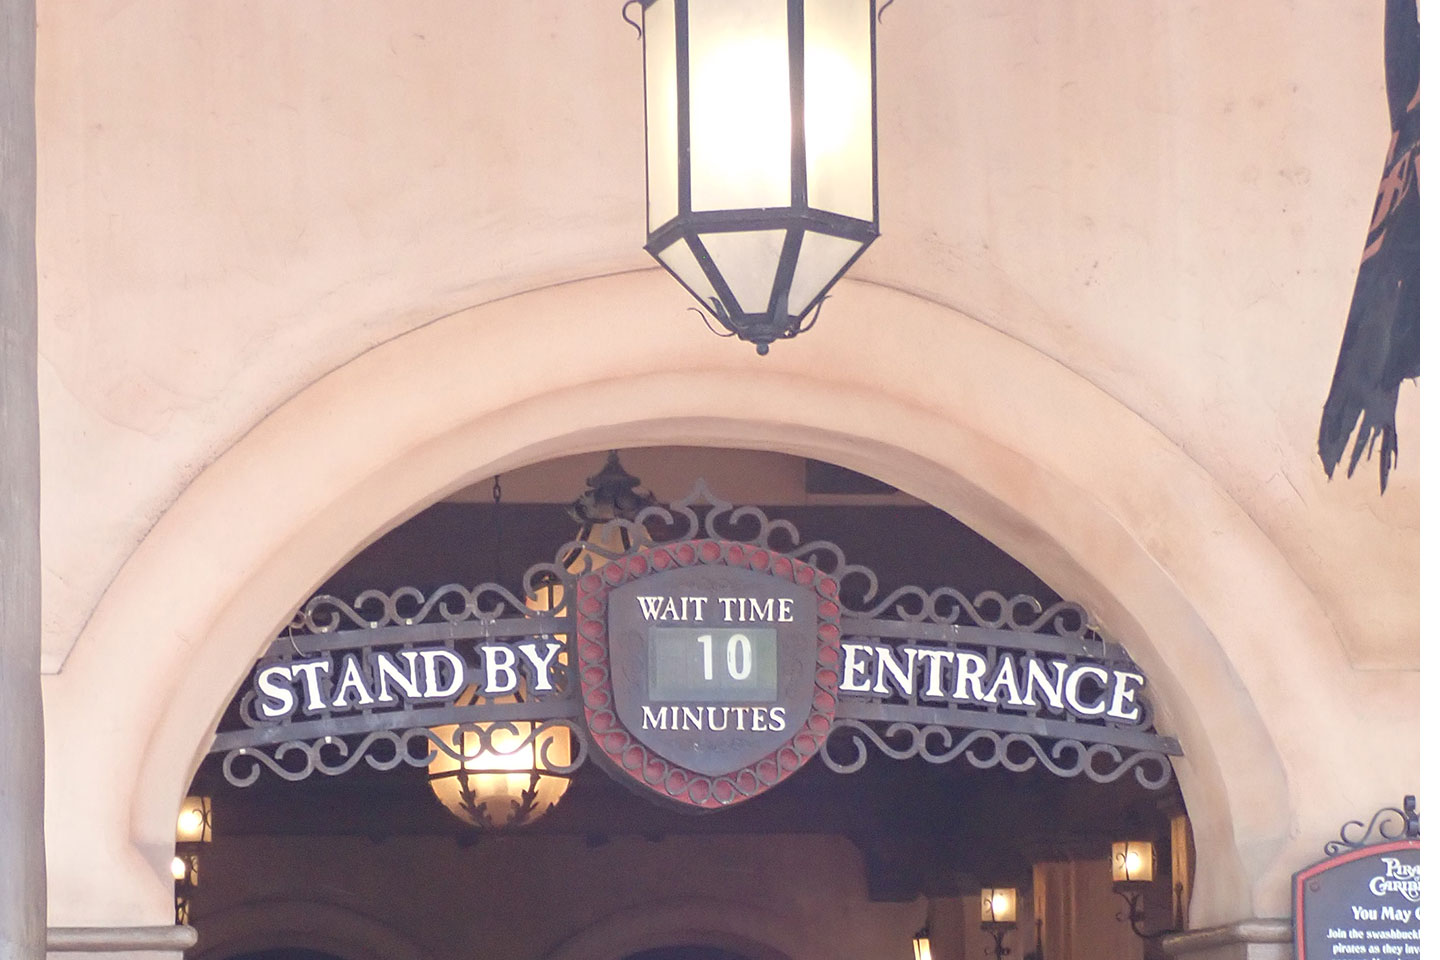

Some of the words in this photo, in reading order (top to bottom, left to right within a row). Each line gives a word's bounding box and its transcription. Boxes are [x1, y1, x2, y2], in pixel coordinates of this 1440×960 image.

[637, 596, 708, 621] WAIT
[718, 598, 794, 622] TIME
[697, 634, 752, 680] 10
[257, 648, 464, 718] STAND
[480, 641, 562, 694] BY
[839, 644, 1144, 720] ENTRANCE
[641, 706, 786, 731] MINUTES
[1351, 905, 1378, 921] You
[1381, 906, 1412, 924] May
[1326, 928, 1347, 939] Join
[1348, 928, 1364, 939] the
[1332, 942, 1367, 955] pirates
[1368, 945, 1380, 954] as
[1382, 943, 1403, 956] they
